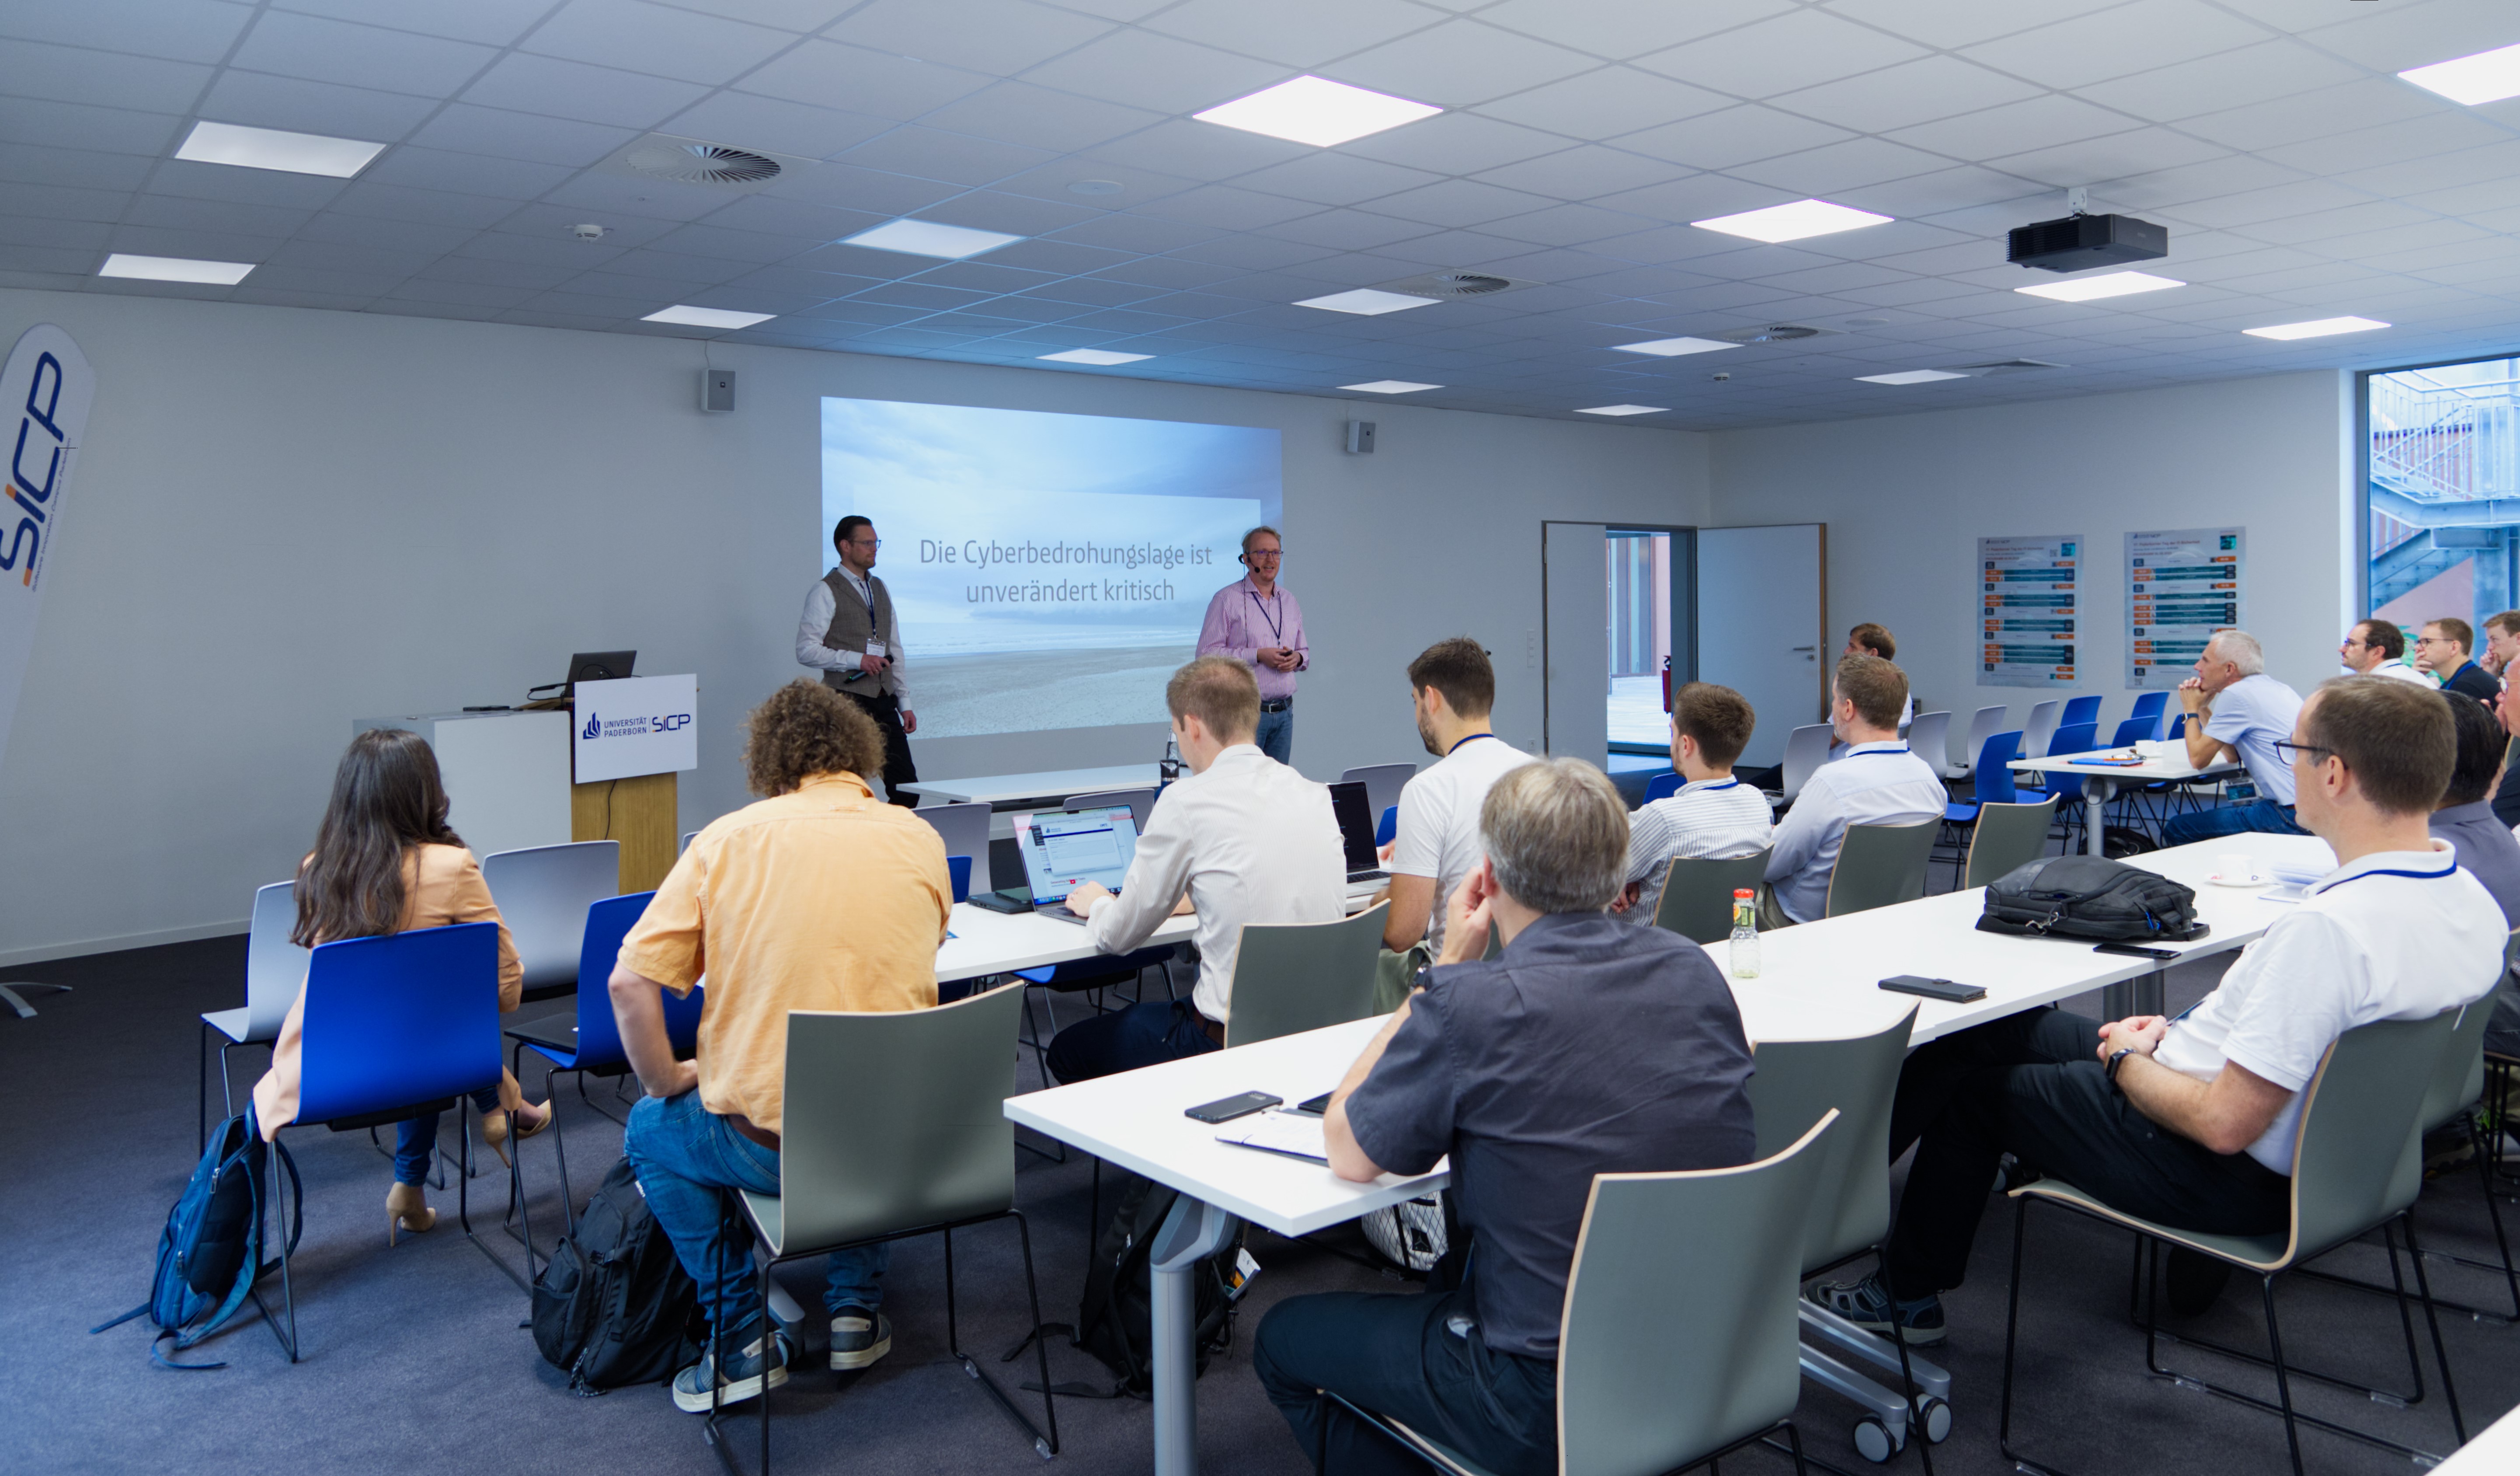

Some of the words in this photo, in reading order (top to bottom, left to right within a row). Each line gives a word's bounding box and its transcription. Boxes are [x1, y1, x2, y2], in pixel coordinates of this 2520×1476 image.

[32, 556, 44, 593] Software
[41, 513, 54, 554] Innovation
[52, 478, 62, 512] Campus
[59, 437, 71, 477] Paderborn
[920, 539, 957, 564] Die
[964, 539, 1185, 569] Cyberbedrohungslage
[1190, 544, 1212, 565] ist
[966, 579, 1098, 603] unverändert
[1104, 579, 1175, 601] kritisch
[604, 716, 647, 729] UNIVERSITÄT
[604, 727, 647, 737] PADERBORN
